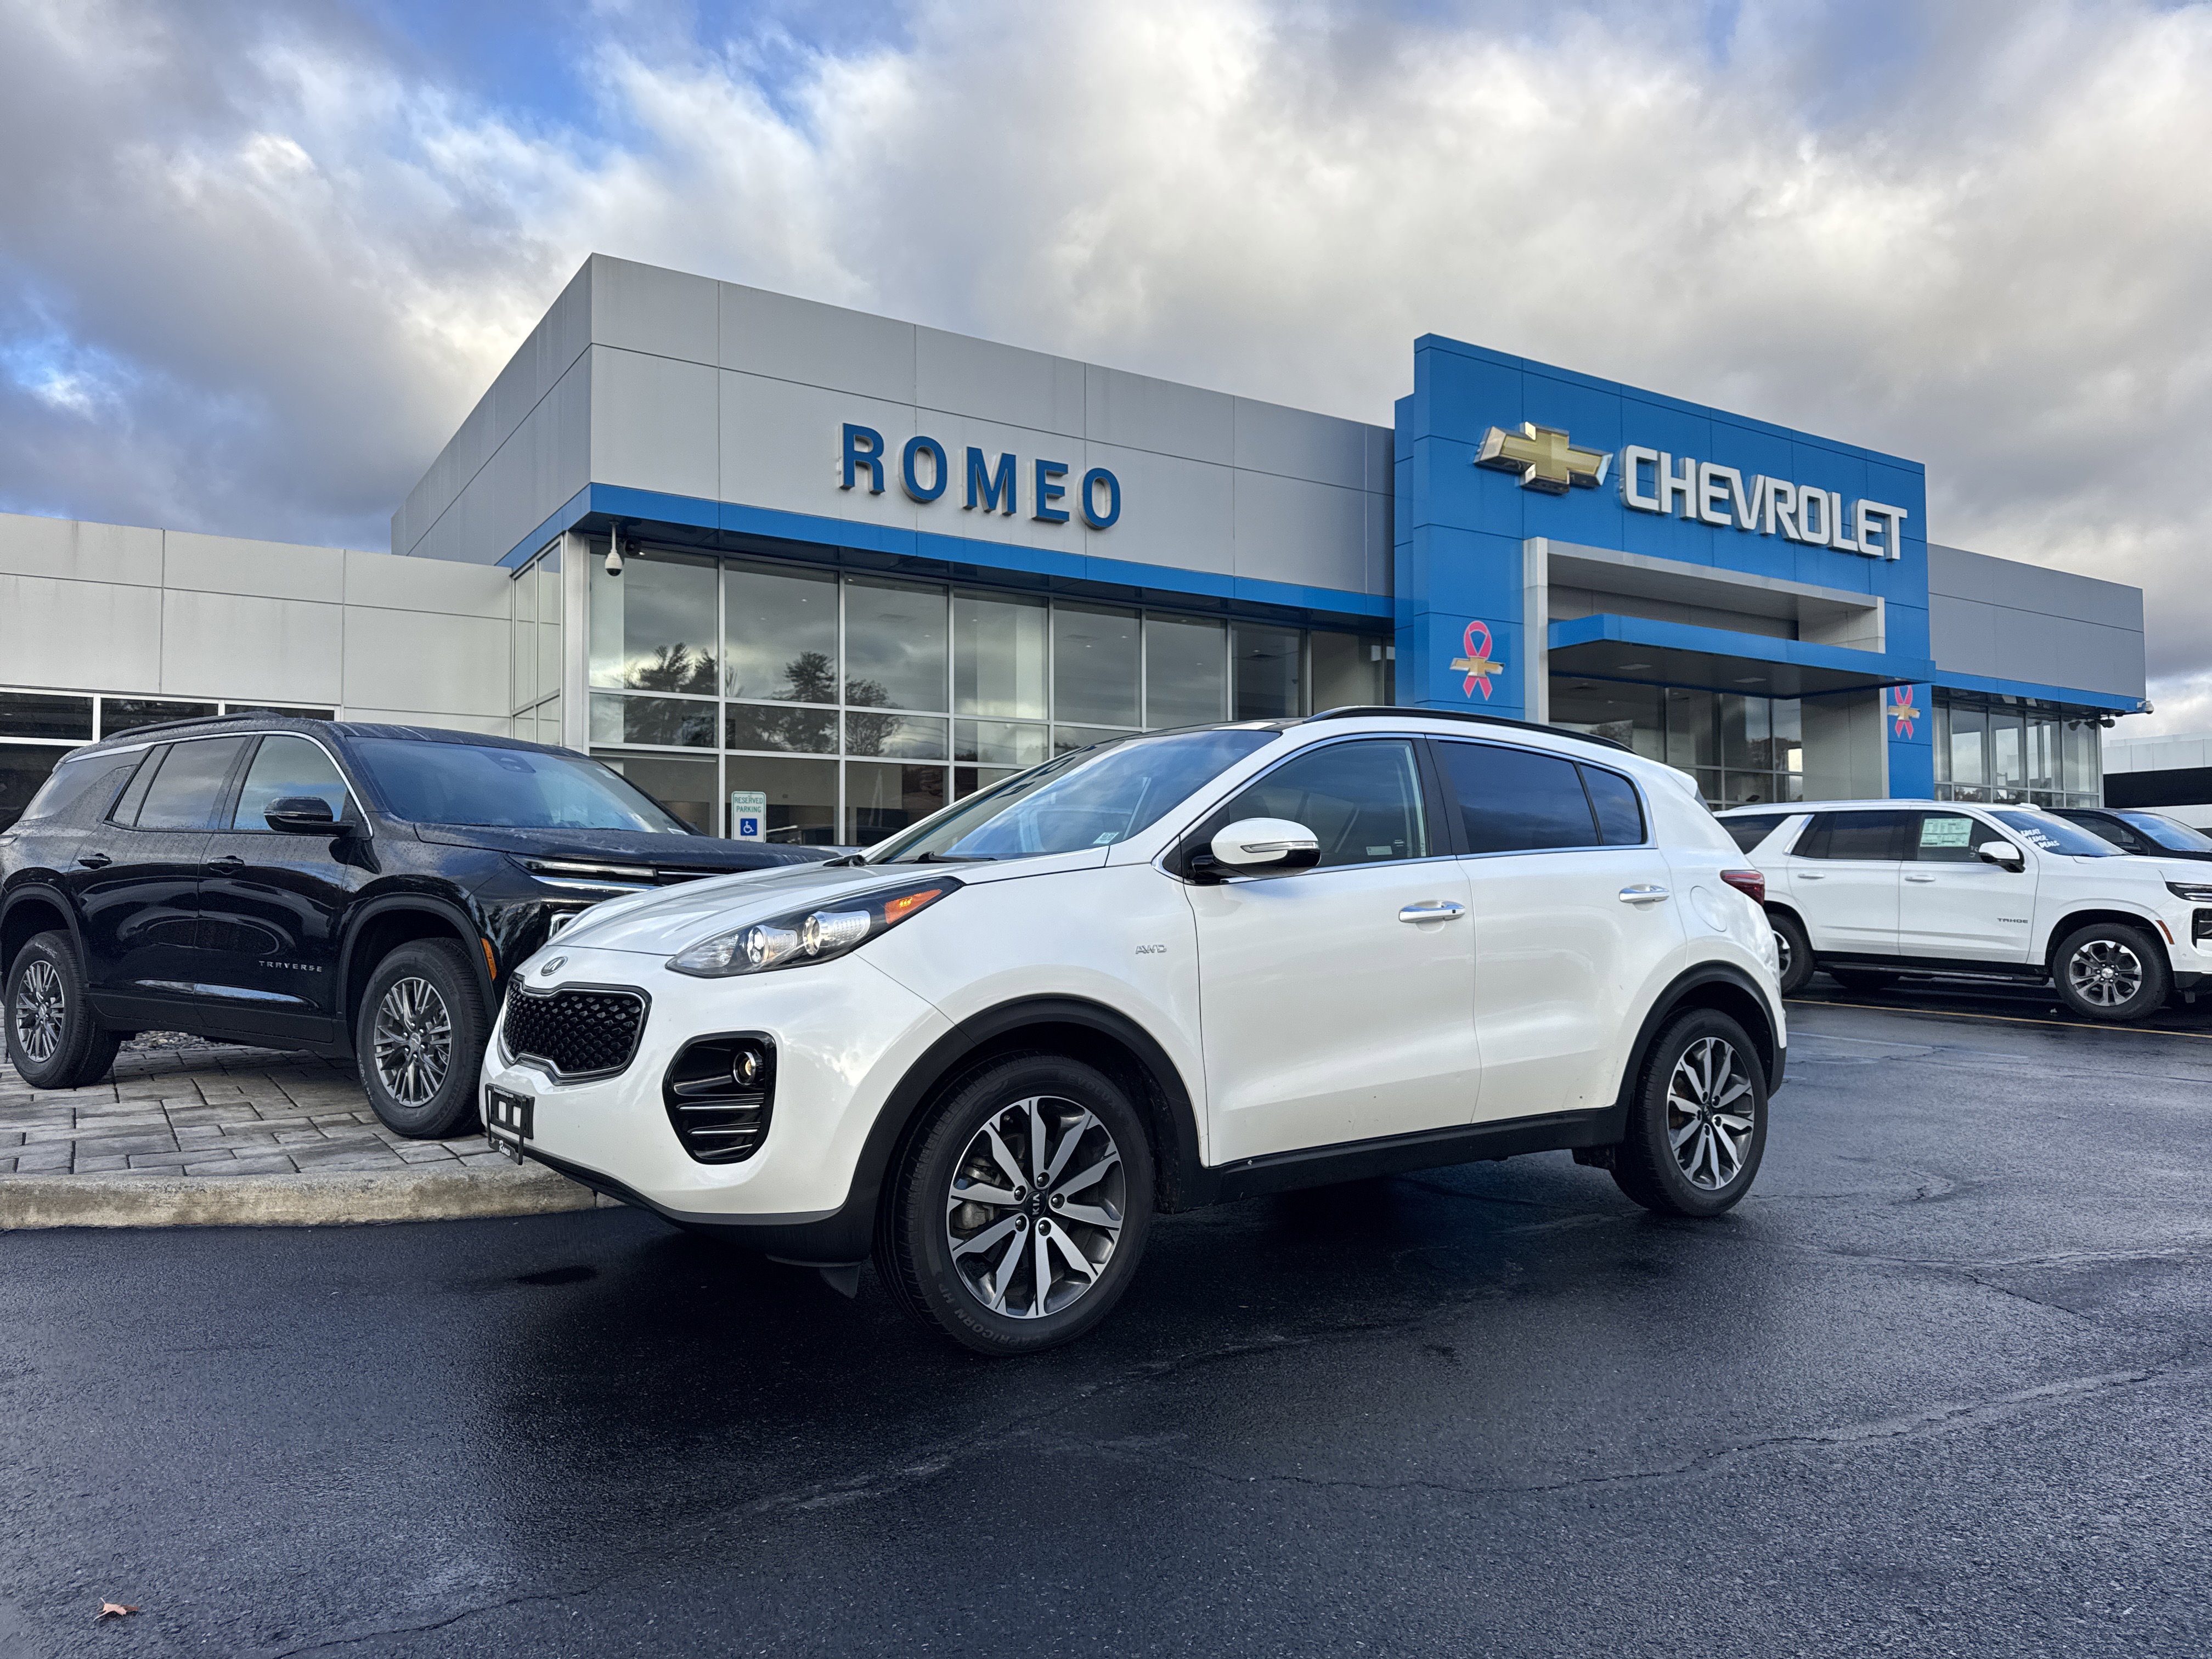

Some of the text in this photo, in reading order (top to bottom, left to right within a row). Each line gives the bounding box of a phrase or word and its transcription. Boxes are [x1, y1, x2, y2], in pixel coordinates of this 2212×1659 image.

[838, 422, 1121, 530] ROMEO
[1621, 444, 1908, 561] CHEVROLET
[1135, 944, 1167, 955] AWD
[258, 961, 322, 972] TRAVERSE
[1032, 1193, 1040, 1215] KIA
